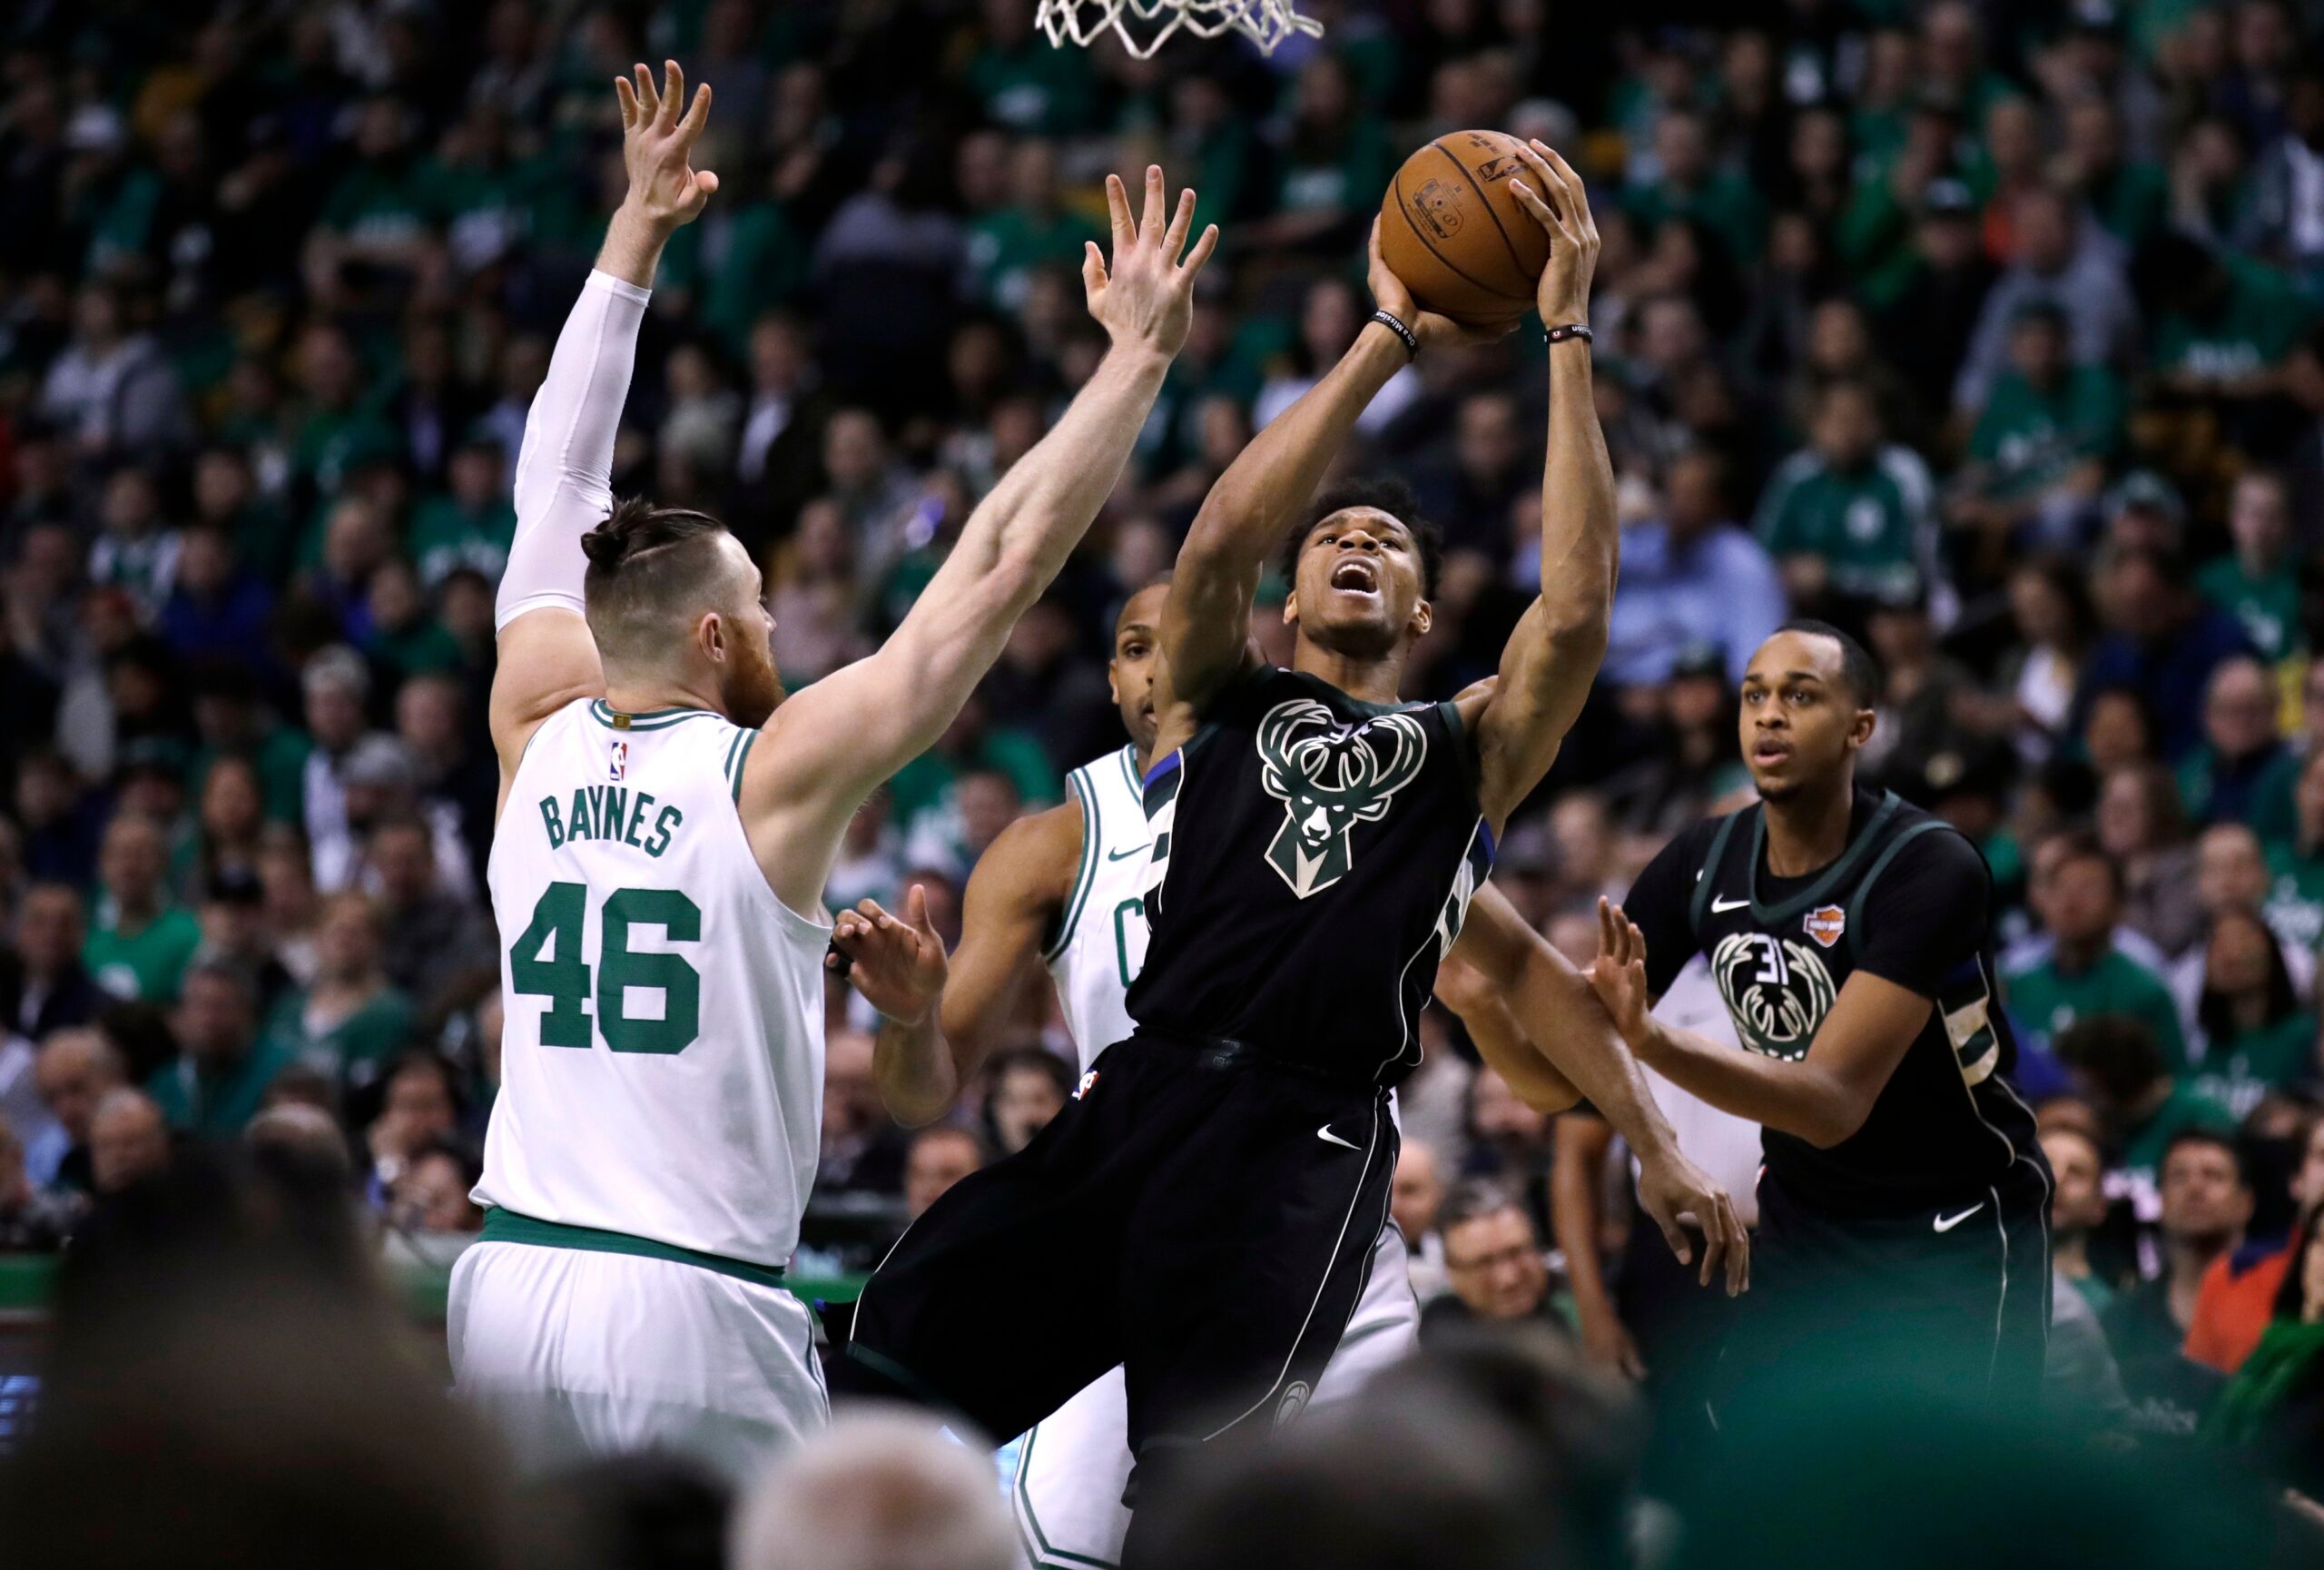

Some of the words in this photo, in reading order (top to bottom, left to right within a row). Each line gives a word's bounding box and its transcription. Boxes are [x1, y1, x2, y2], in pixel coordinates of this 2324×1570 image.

[1375, 311, 1404, 332] Mission
[1407, 334, 1416, 347] On
[538, 785, 684, 859] BAYNES
[509, 881, 702, 1055] 46
[1753, 933, 1789, 986] 31
